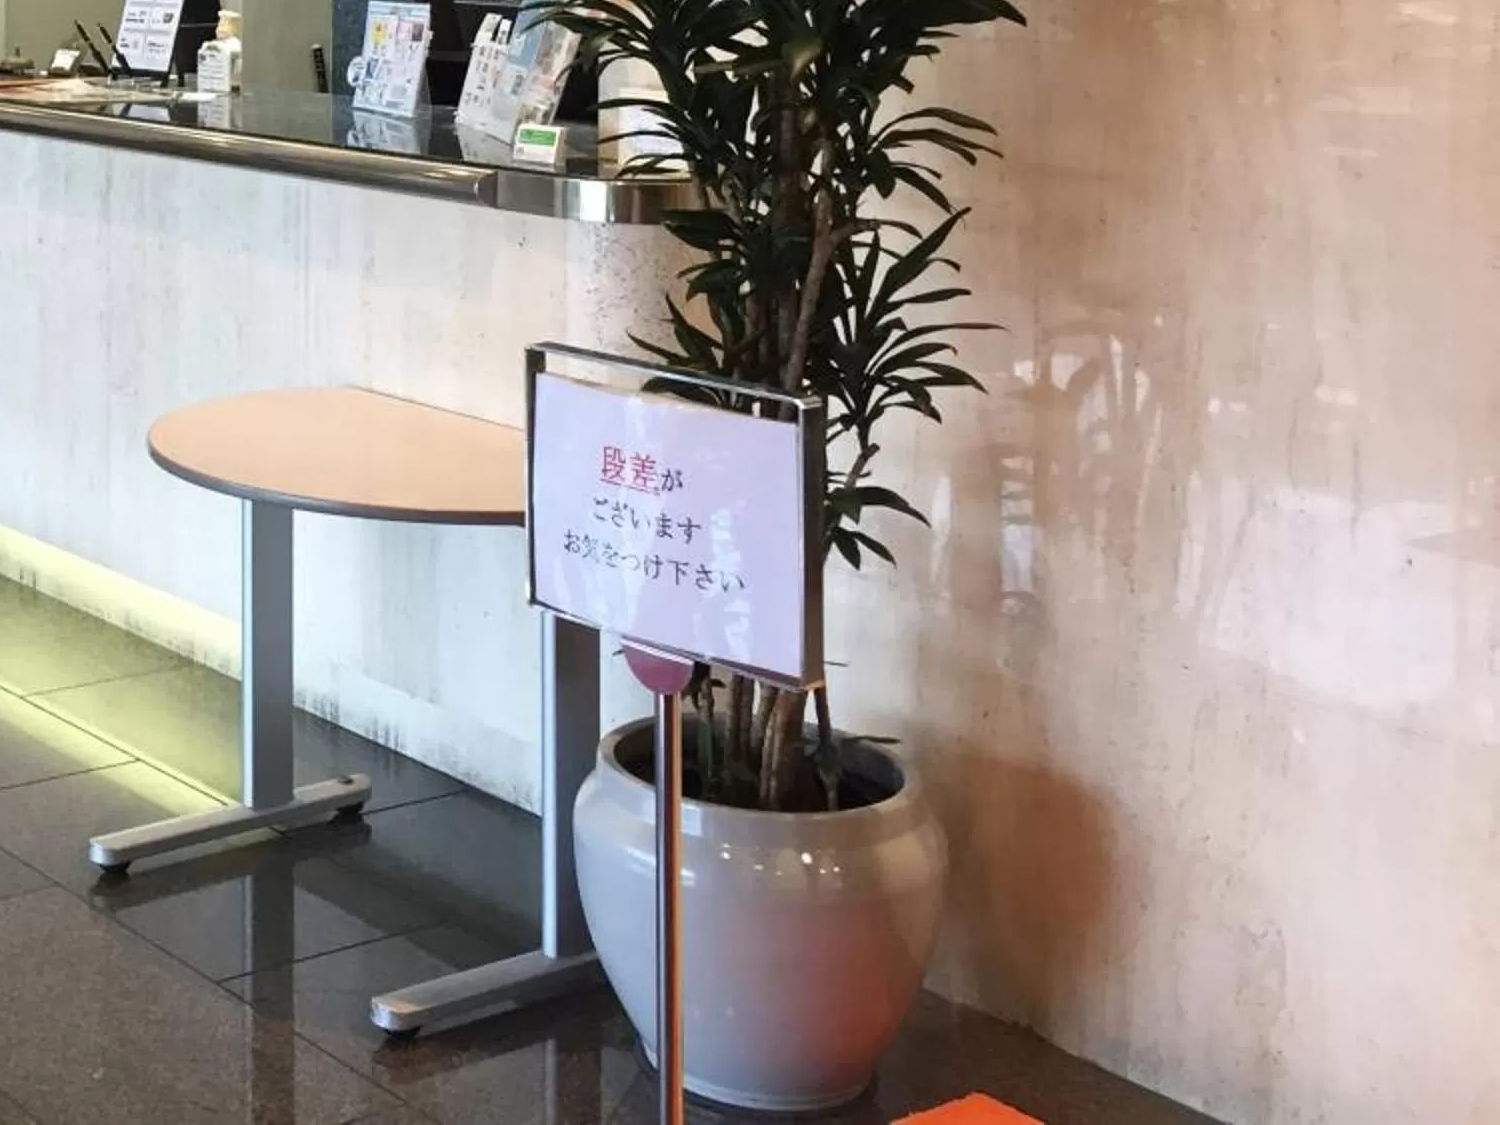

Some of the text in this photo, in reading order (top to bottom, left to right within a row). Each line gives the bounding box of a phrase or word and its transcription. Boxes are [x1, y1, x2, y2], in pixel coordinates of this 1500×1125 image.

[601, 446, 683, 493] 段差が
[593, 496, 701, 545] ございます
